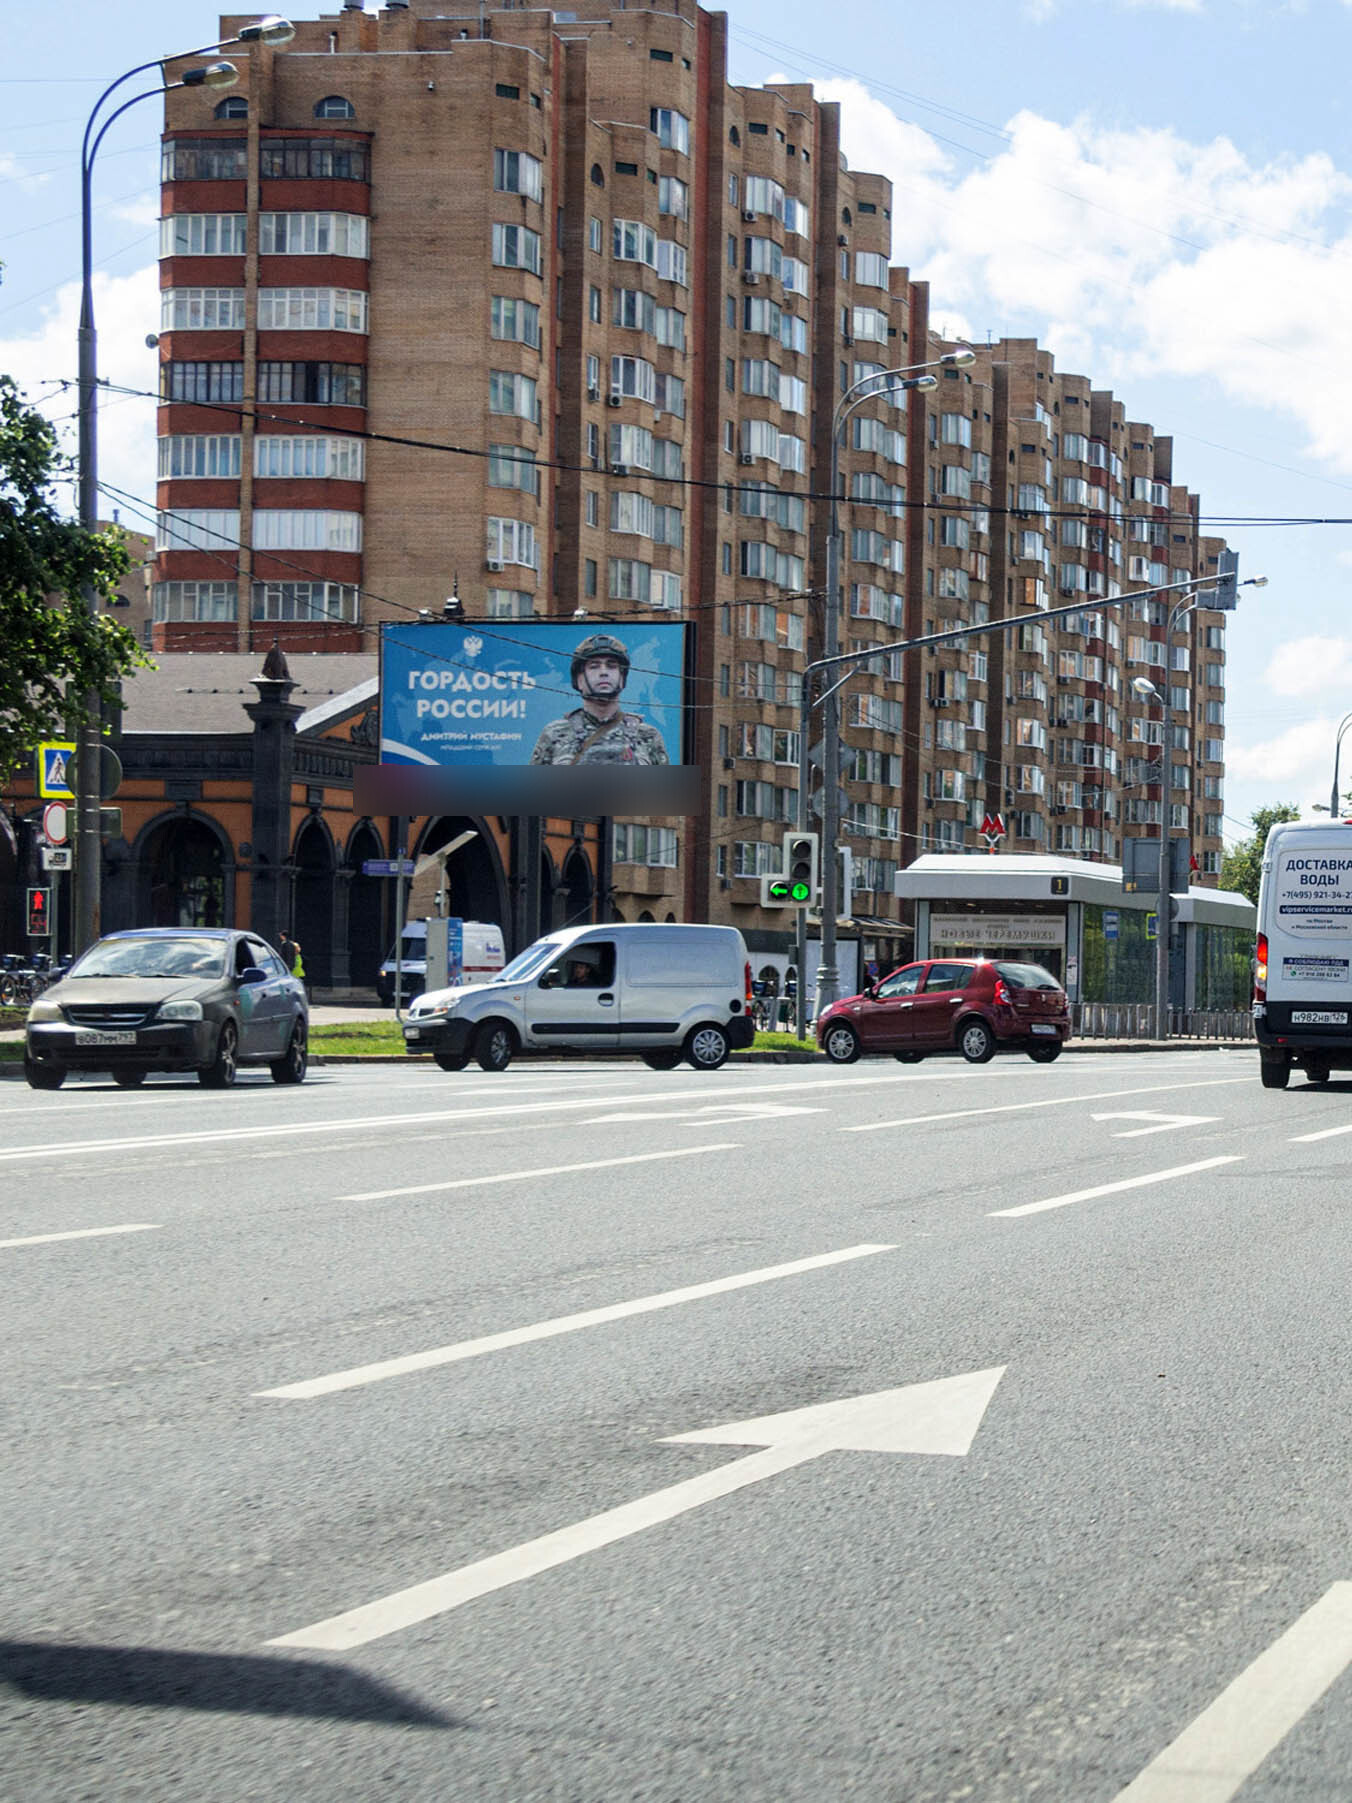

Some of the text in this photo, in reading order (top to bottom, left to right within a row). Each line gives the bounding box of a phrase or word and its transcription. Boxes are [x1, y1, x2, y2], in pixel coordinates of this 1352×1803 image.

[408, 671, 536, 692] ГОРДОСТЬ
[416, 699, 526, 718] РОССИИ!
[421, 731, 467, 741] ДМИТРИЙ
[1300, 875, 1339, 887] ВОДЫ
[1282, 891, 1312, 899] +7(495)
